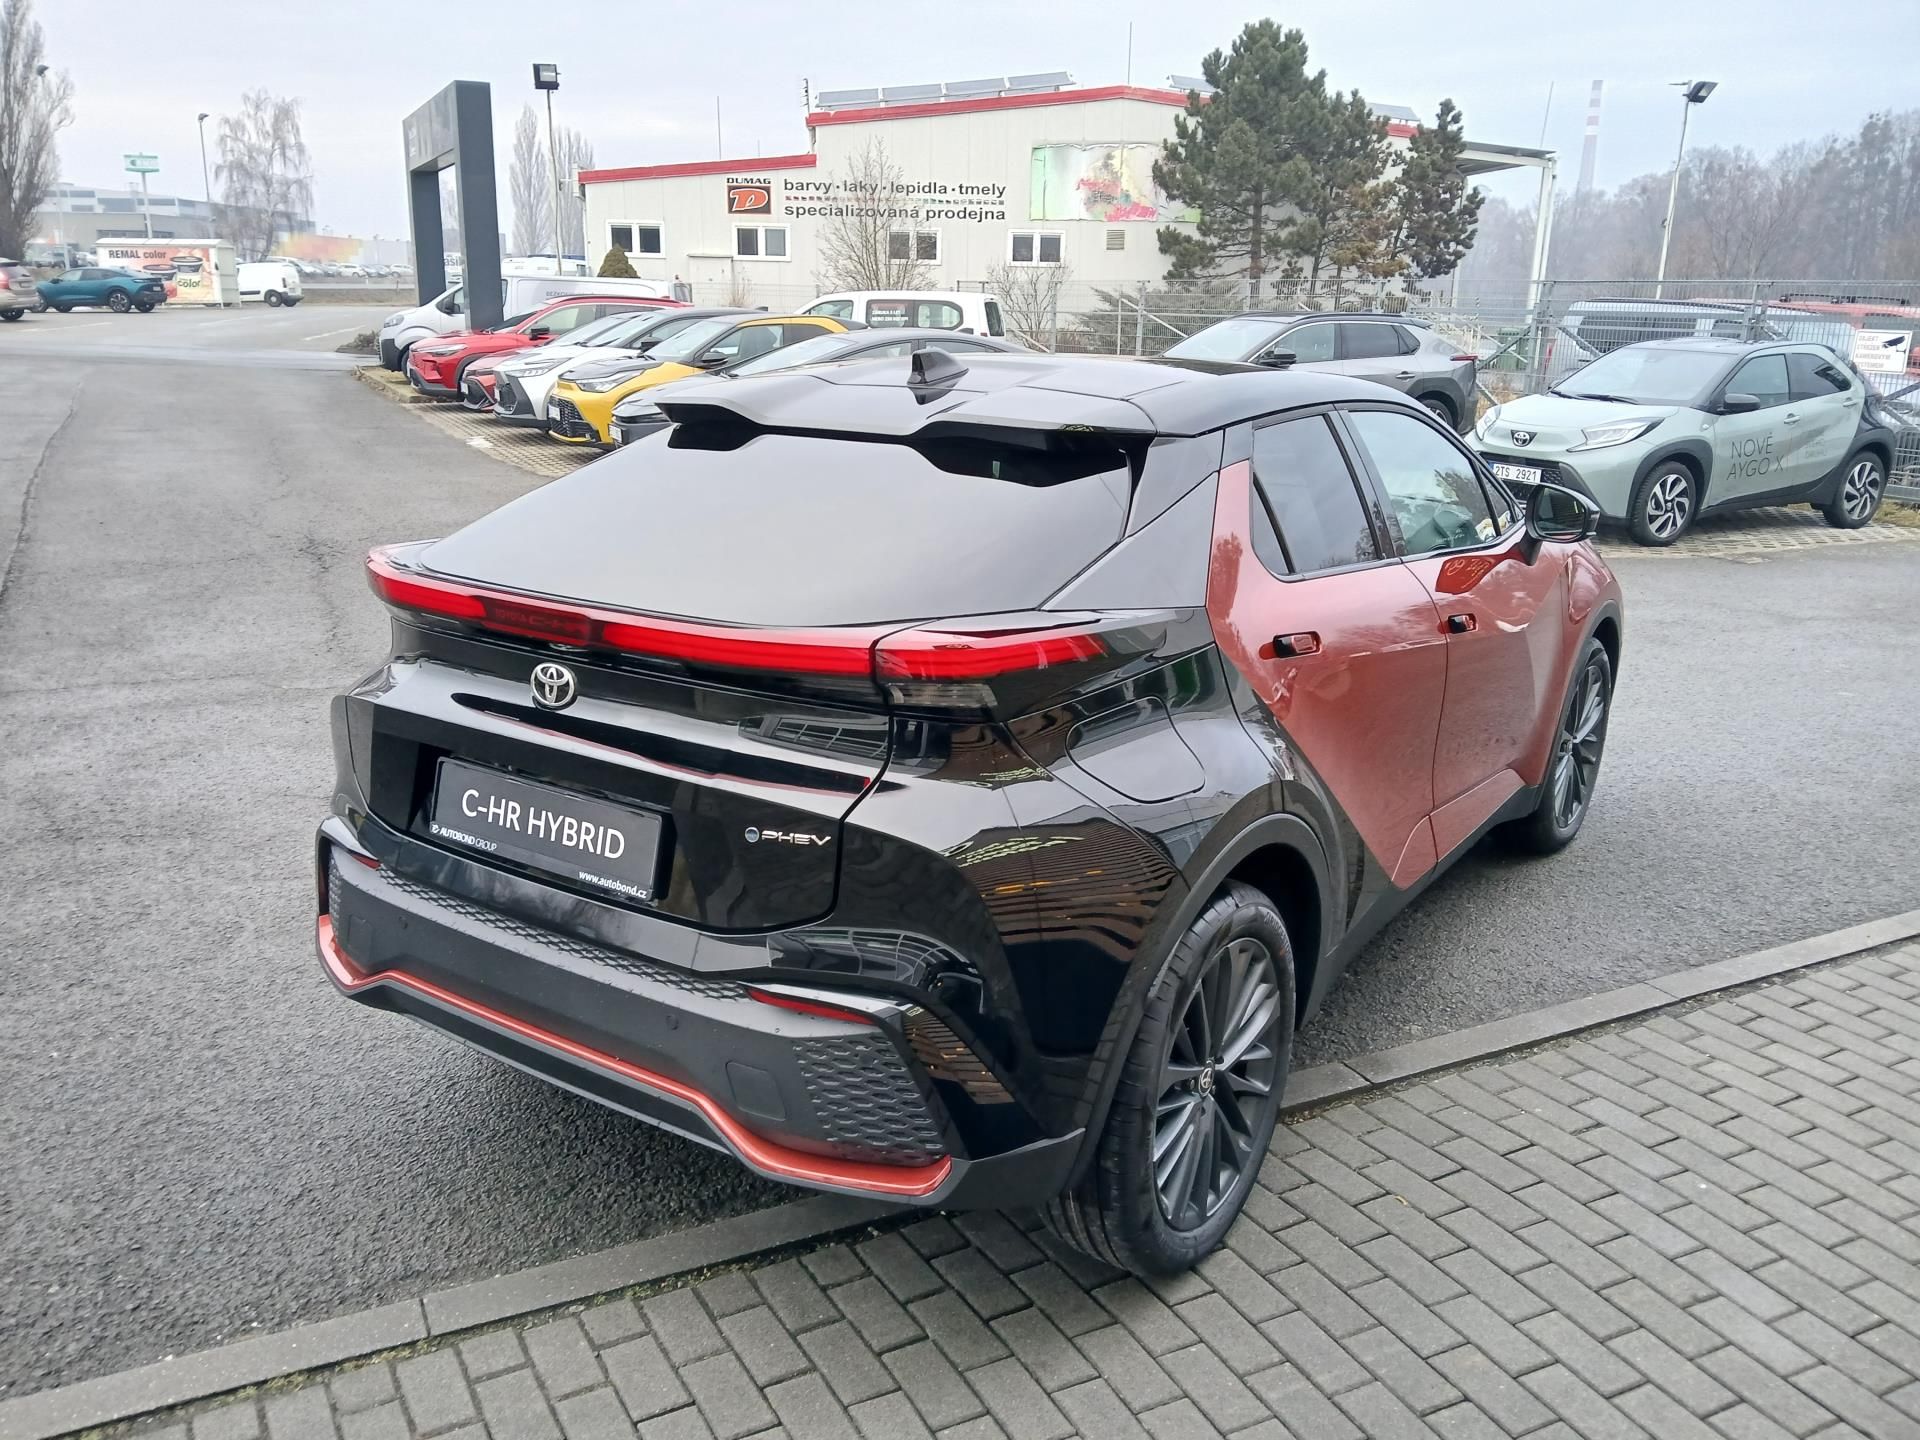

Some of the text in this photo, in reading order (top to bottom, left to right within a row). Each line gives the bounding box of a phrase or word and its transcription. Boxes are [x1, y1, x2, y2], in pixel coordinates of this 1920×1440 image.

[726, 177, 771, 185] DUMAG
[784, 178, 1006, 198] barvy laky lepidla tmely
[784, 204, 1006, 223] specializovaná prodejna
[108, 249, 167, 259] REMAL color
[178, 278, 201, 288] color
[1495, 465, 1537, 481] 2TS 2921
[1726, 455, 1785, 480] AYGO X
[461, 788, 625, 860] C-HR HYBRID
[440, 827, 498, 852] AUTOBOND GROUP
[761, 830, 832, 846] PHEV
[578, 871, 648, 899] www.autobond.cz
